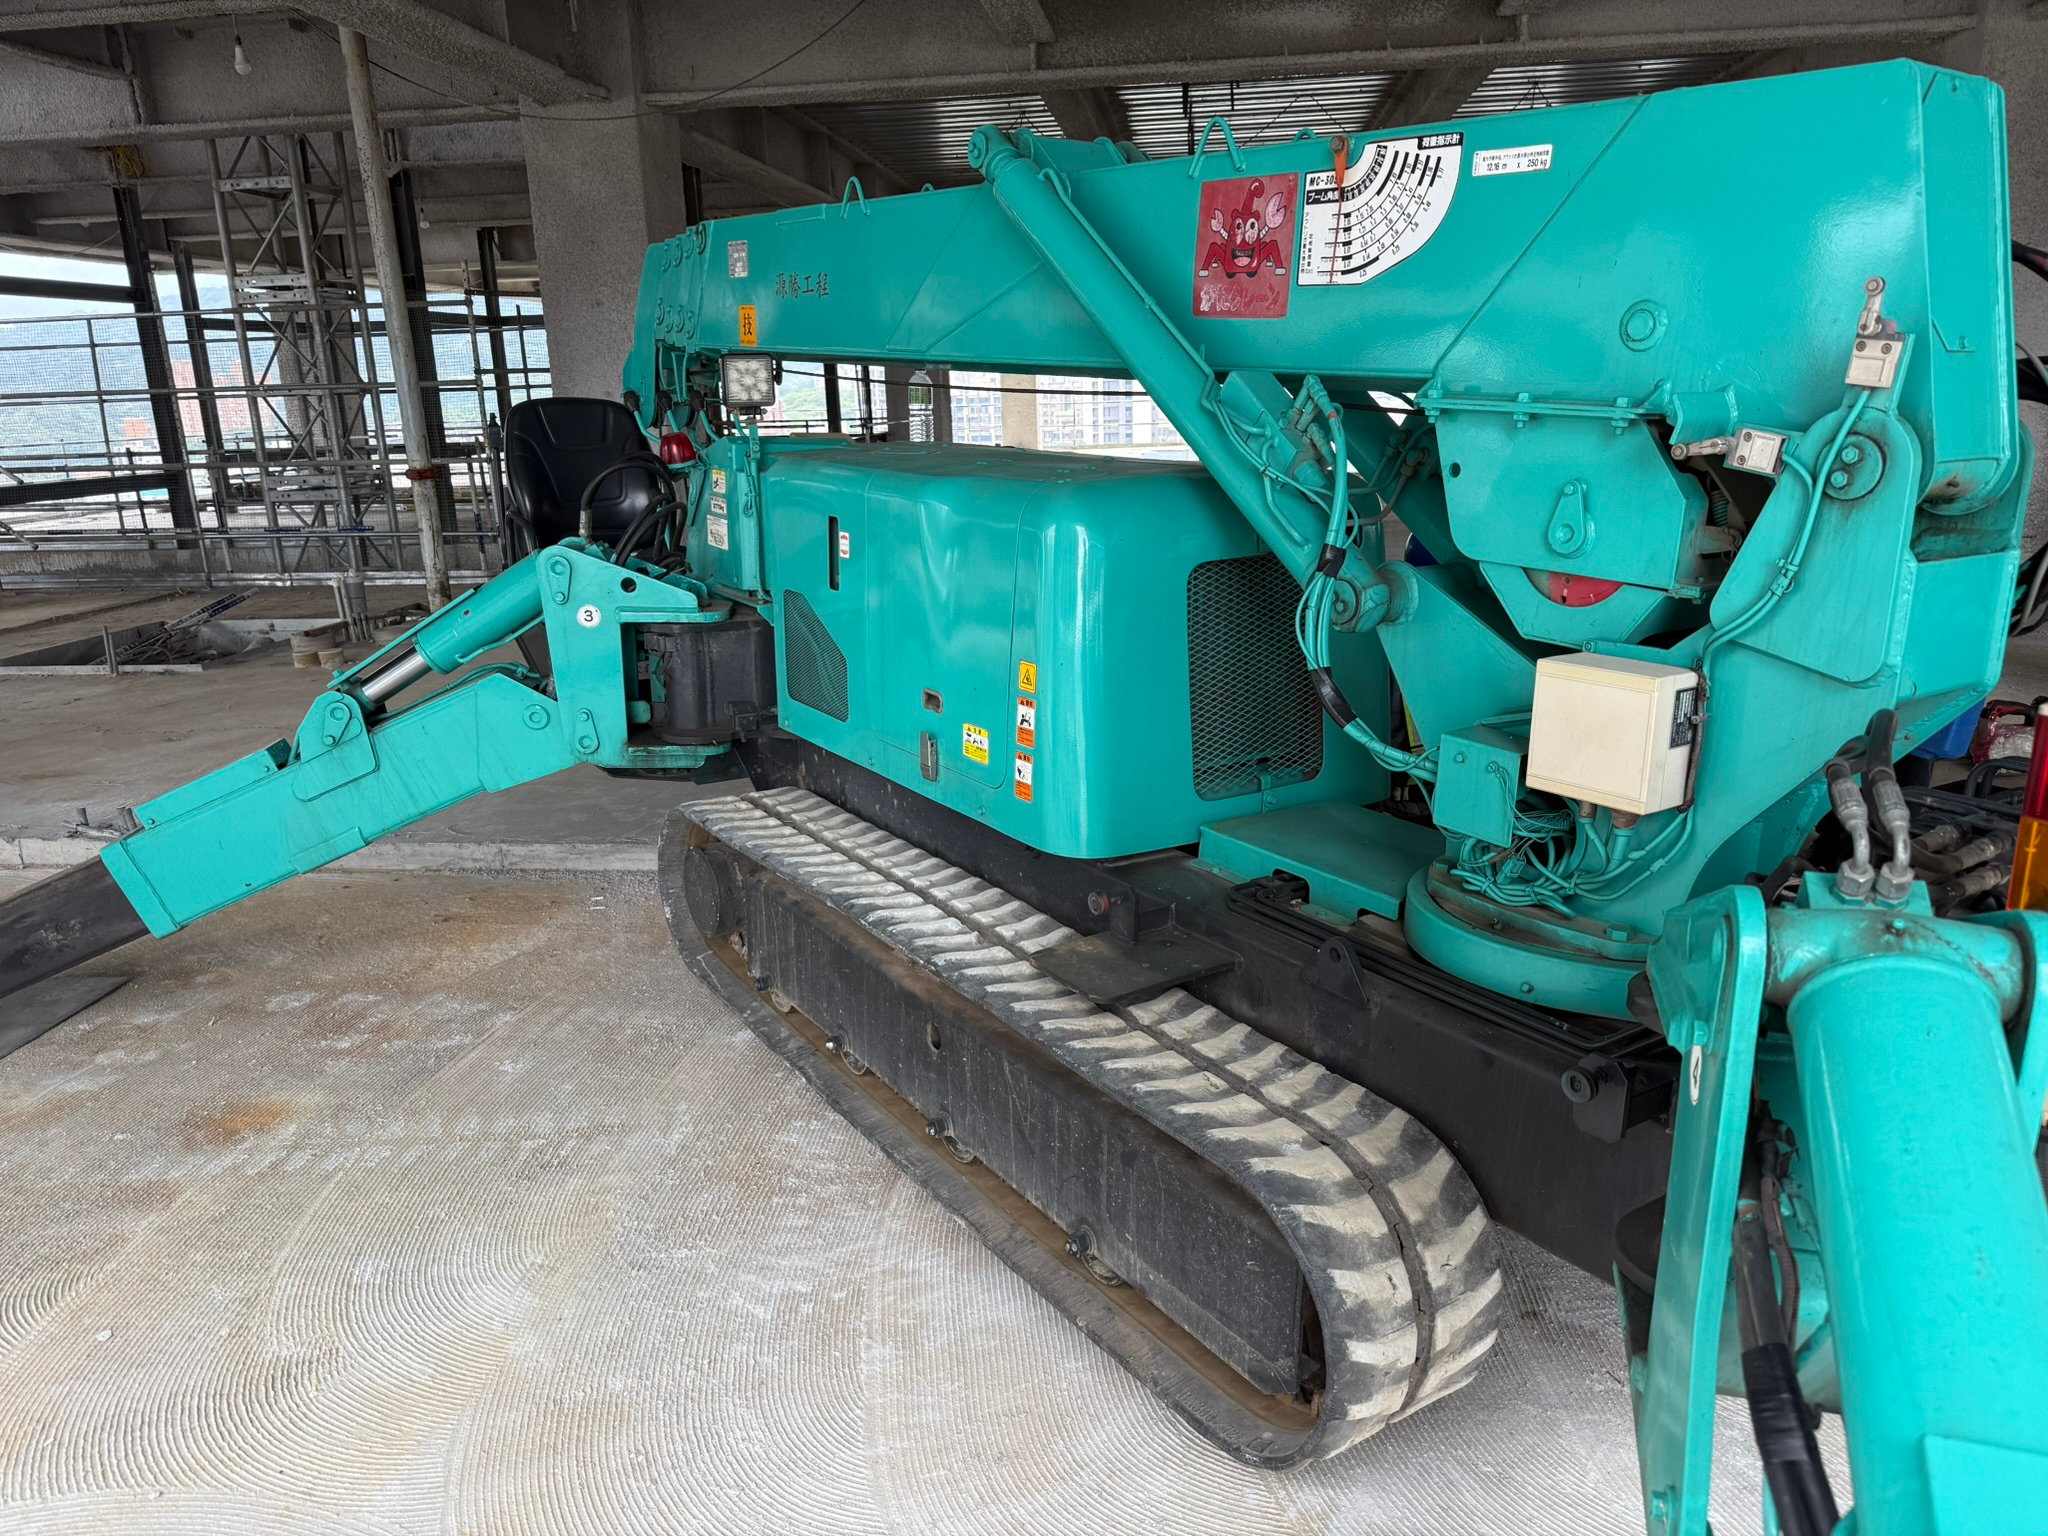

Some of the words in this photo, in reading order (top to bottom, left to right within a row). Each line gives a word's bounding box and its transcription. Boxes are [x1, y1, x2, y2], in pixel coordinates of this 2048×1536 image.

[1486, 162, 1500, 171] 12.16
[1527, 158, 1539, 168] 250
[1540, 157, 1548, 168] kg
[775, 271, 829, 299] 源勝工程
[584, 609, 593, 622] 3
[1692, 1055, 1700, 1089] 4
